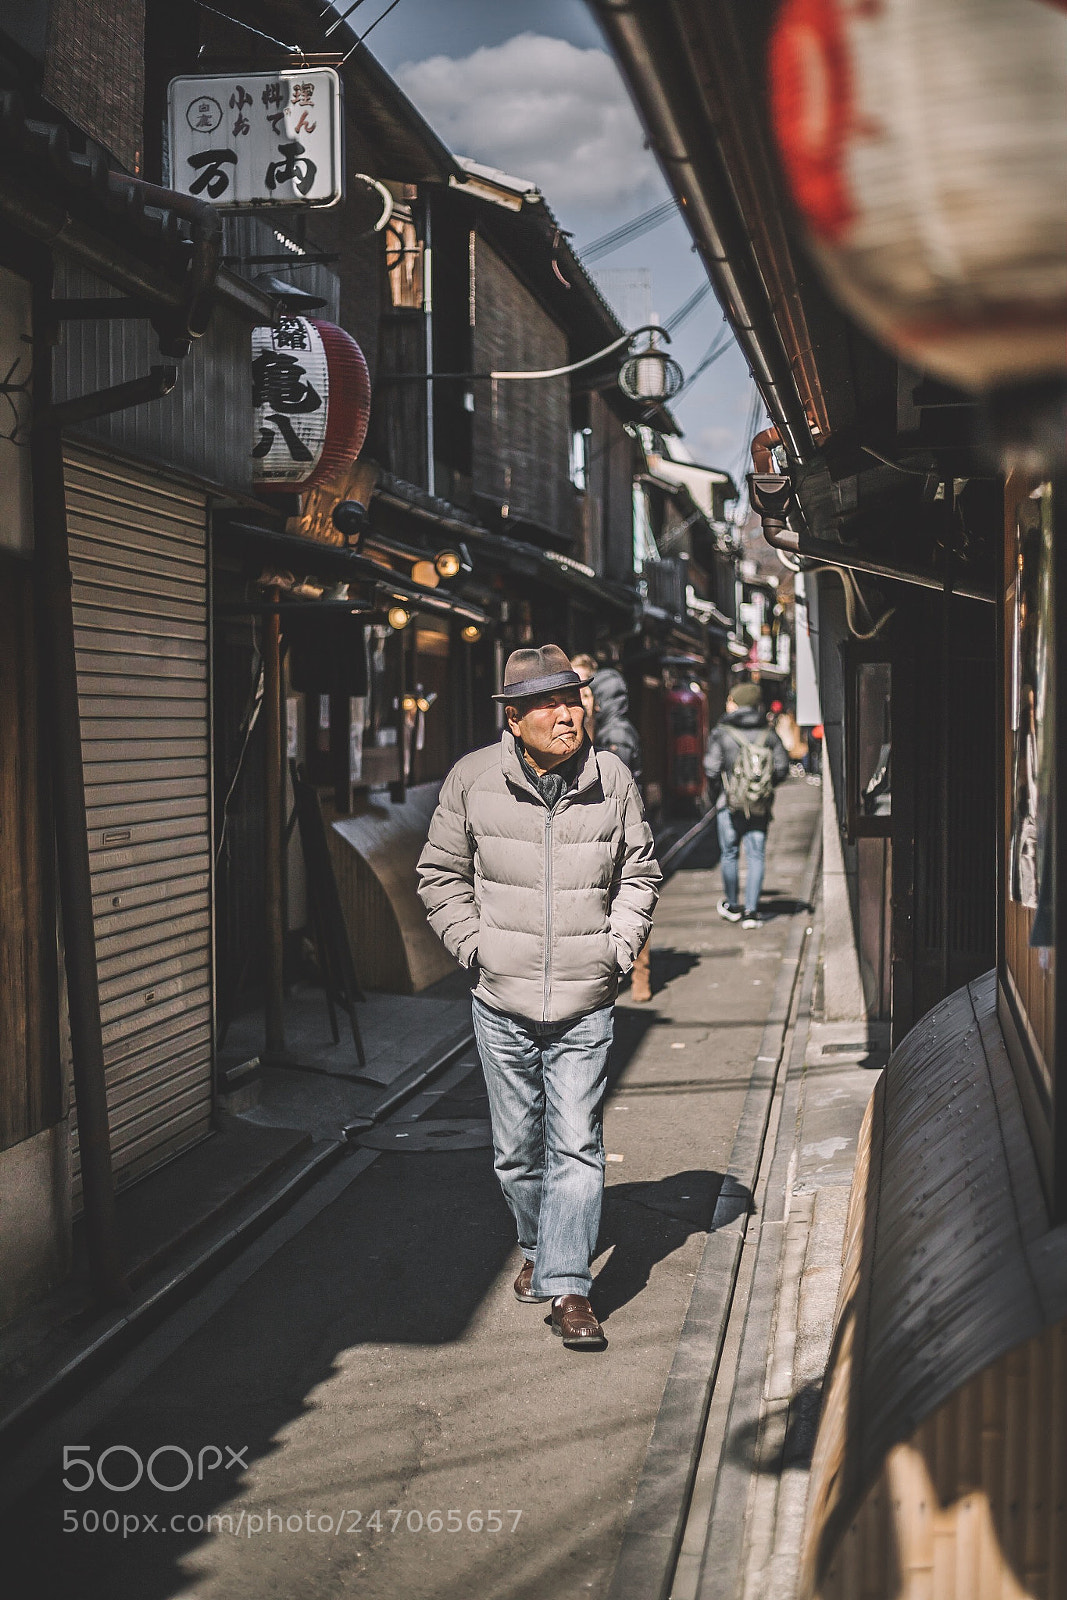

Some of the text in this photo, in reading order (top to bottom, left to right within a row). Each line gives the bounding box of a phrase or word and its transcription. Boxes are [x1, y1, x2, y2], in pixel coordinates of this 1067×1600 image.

[228, 81, 315, 110] 小料理
[231, 108, 317, 136] おでん
[187, 142, 317, 199] 万両
